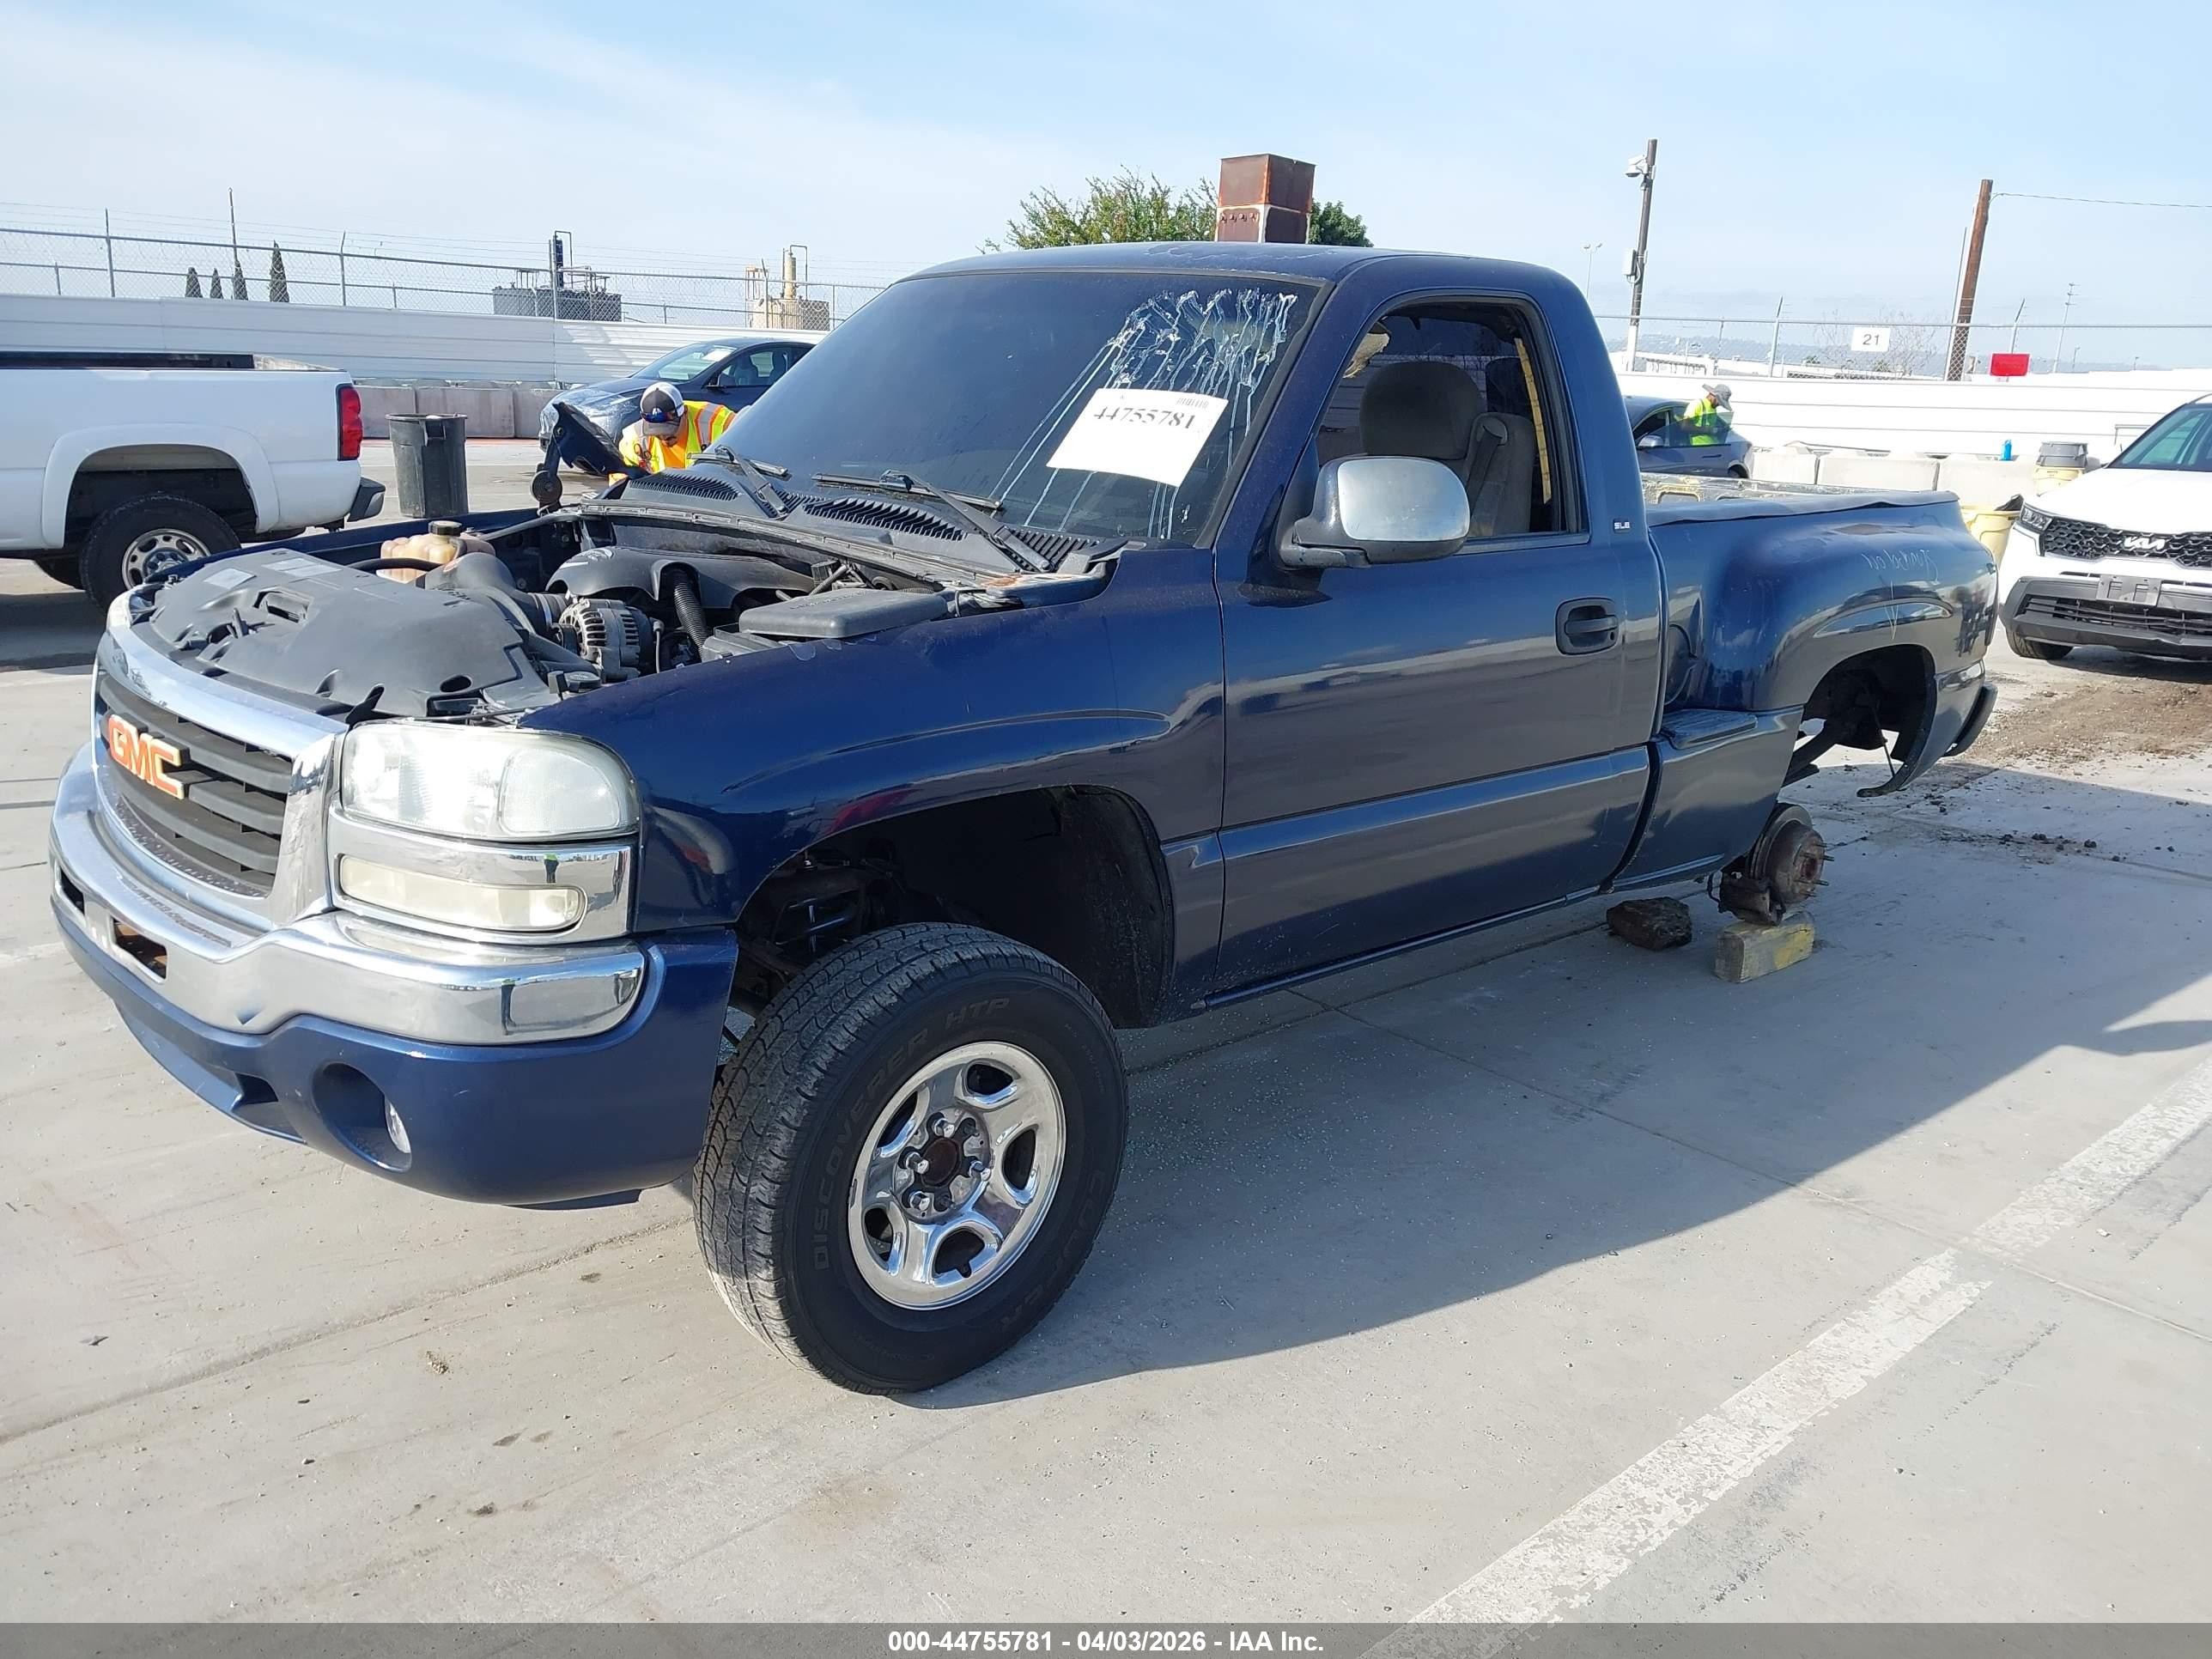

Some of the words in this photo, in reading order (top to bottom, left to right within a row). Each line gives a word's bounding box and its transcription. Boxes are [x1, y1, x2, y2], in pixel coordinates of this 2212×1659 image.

[1862, 334, 1880, 346] 21
[1093, 405, 1196, 429] 44755781
[108, 714, 185, 800] GMC
[812, 1027, 928, 1272] DISCOVERER
[944, 997, 1011, 1030] HTP
